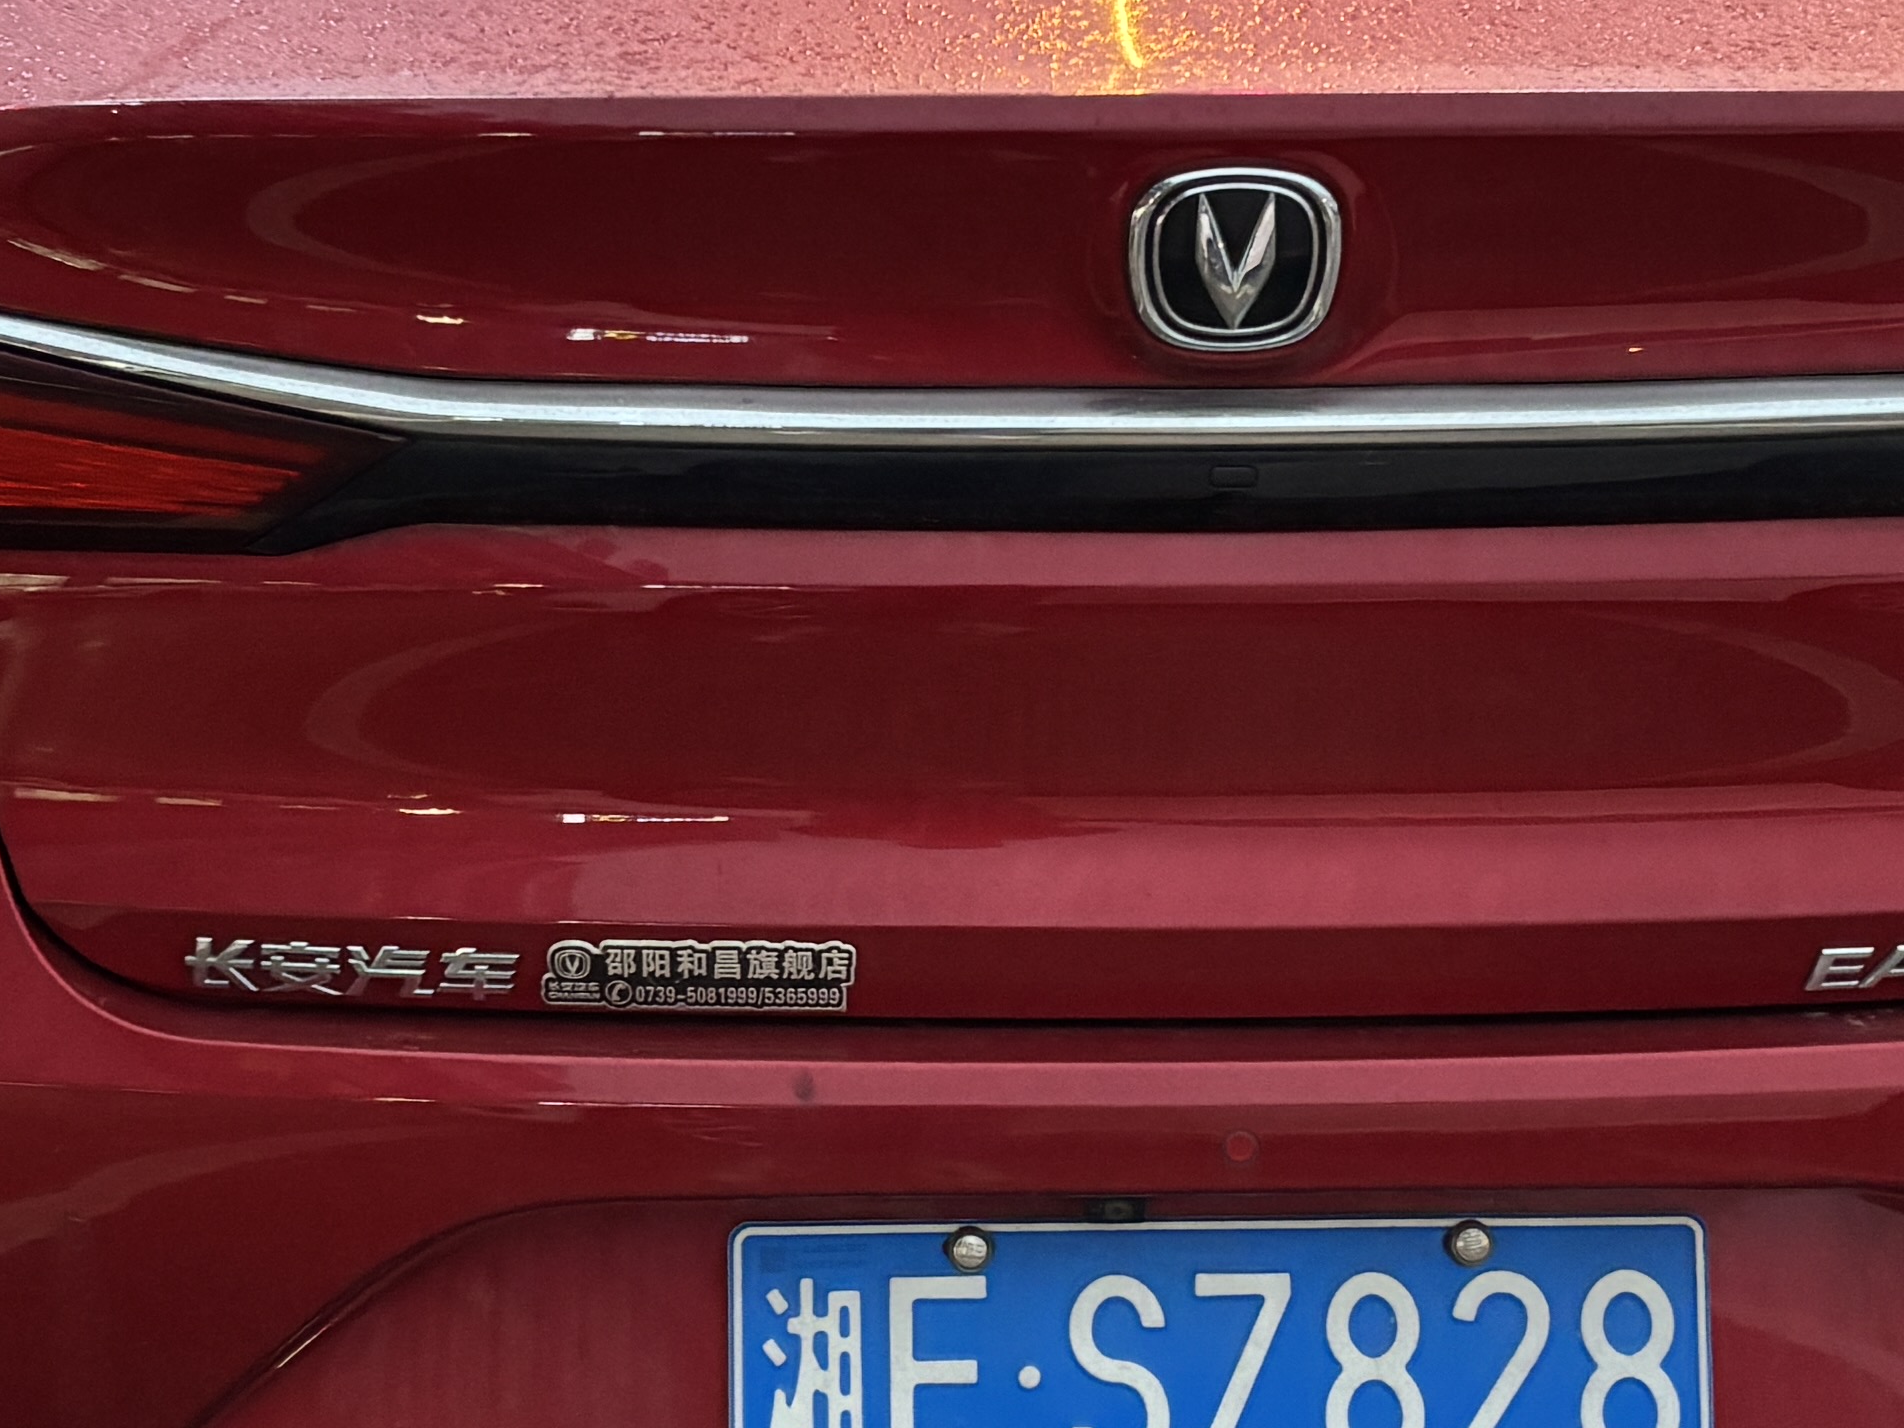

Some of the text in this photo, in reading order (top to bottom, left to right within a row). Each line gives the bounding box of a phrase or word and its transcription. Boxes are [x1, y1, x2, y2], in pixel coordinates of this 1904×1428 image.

[185, 936, 520, 999] 长安汽车
[605, 948, 850, 981] 邵阳和昌旗舰店
[635, 985, 841, 1005] 0739-5081999/5365999
